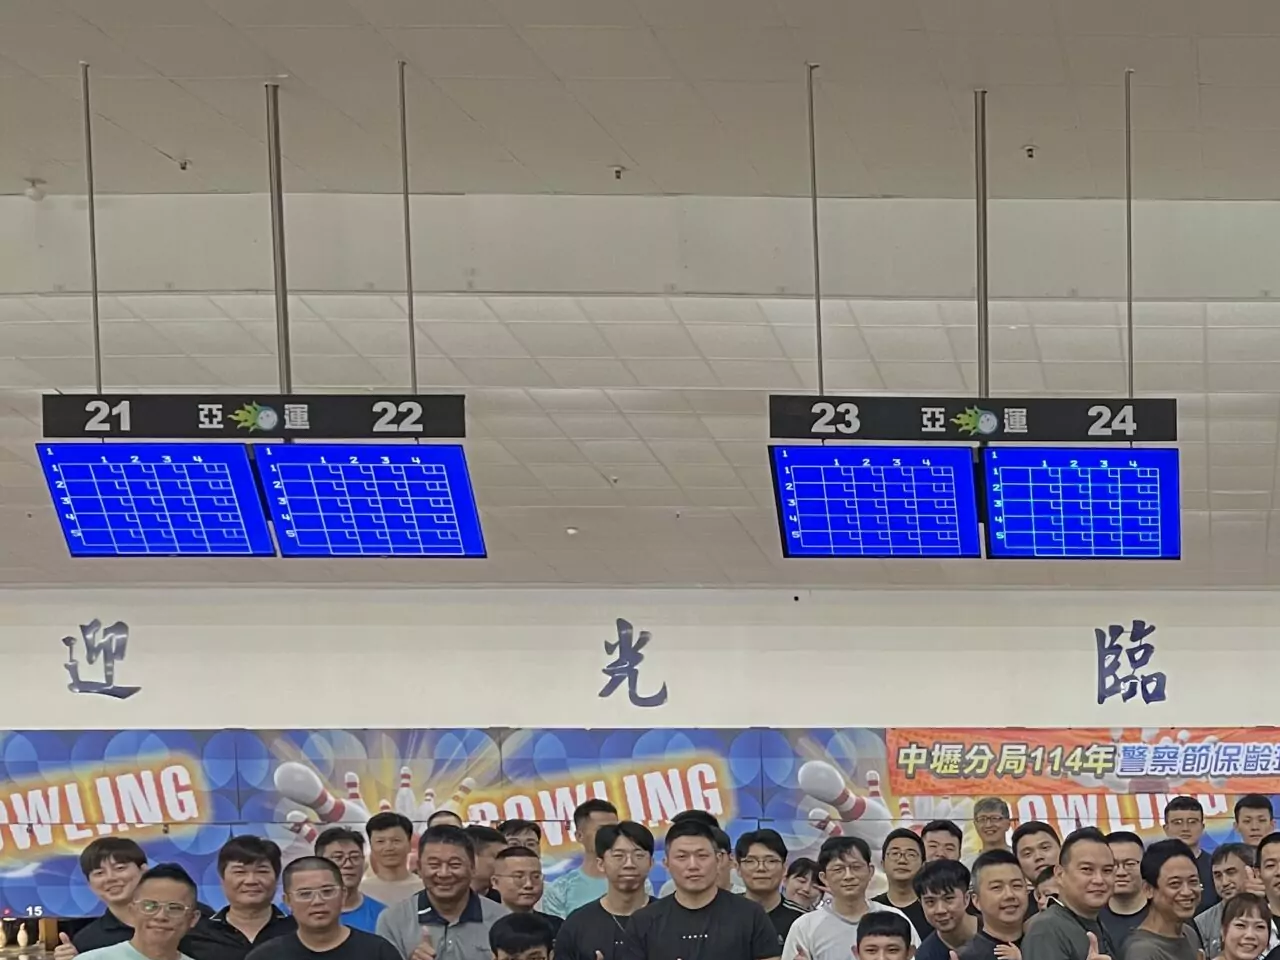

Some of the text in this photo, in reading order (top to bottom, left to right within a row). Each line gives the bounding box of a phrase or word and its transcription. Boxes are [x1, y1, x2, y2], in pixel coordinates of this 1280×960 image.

[85, 401, 130, 431] 21
[372, 402, 423, 432] 22
[811, 402, 860, 433] 23
[1087, 405, 1137, 435] 24
[61, 618, 141, 699] 迎
[598, 618, 667, 707] 光
[1095, 619, 1166, 704] 臨
[0, 765, 198, 849] WLING
[26, 906, 43, 916] 15
